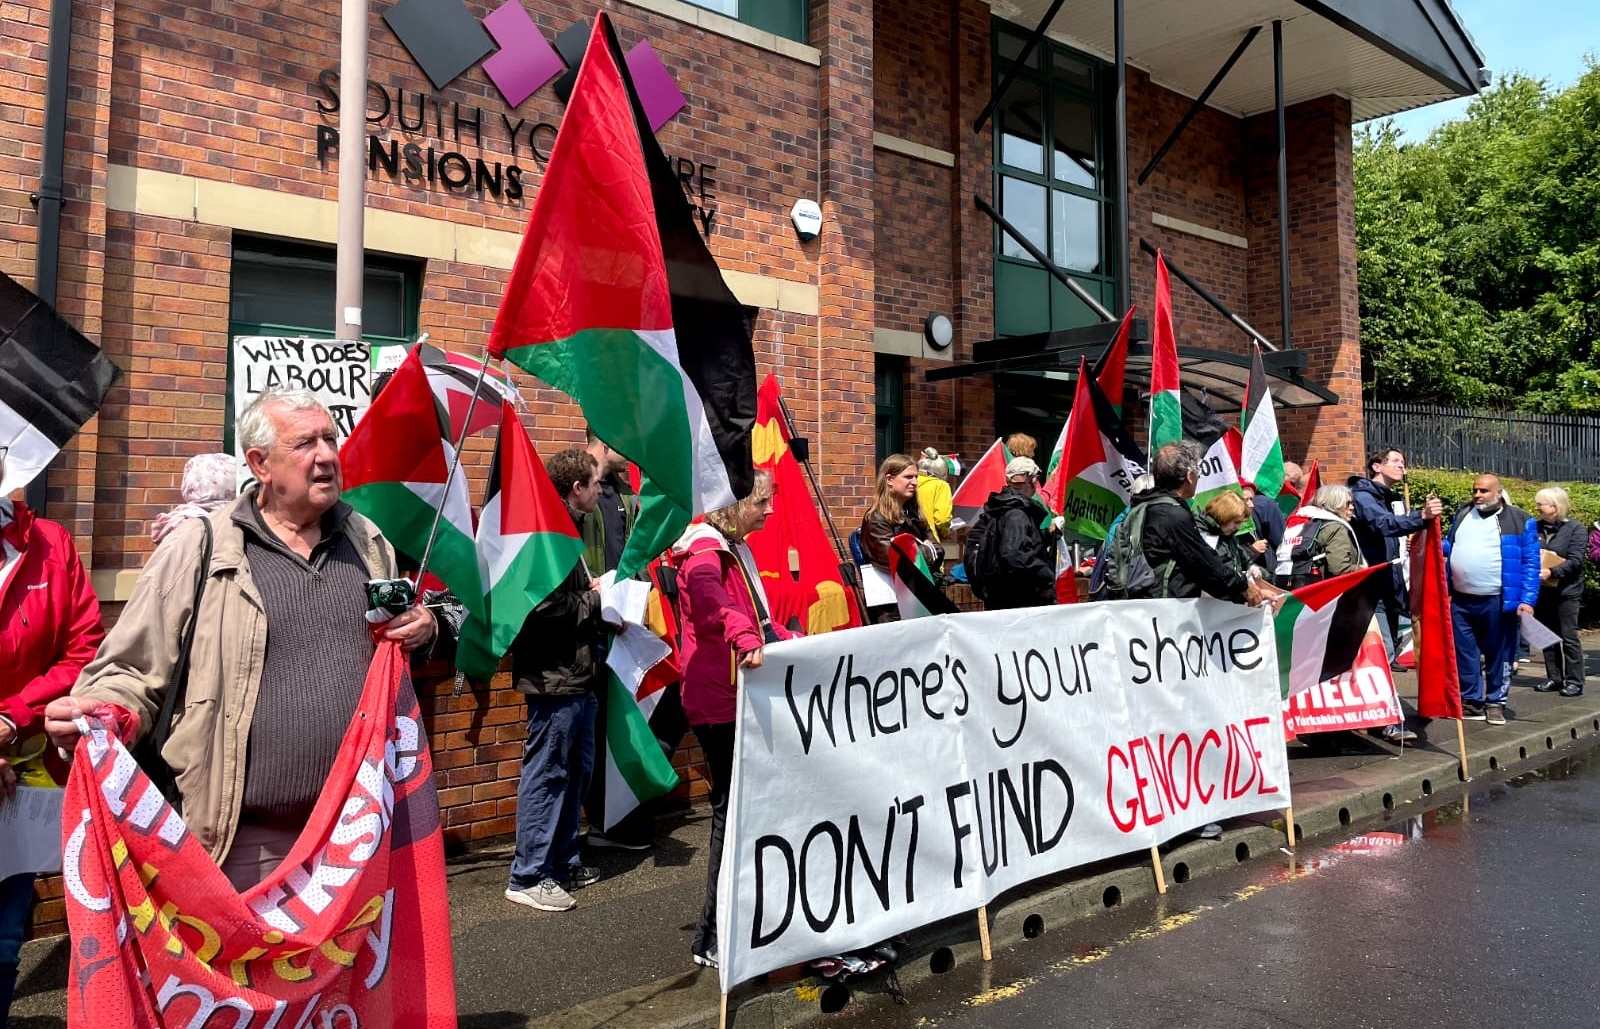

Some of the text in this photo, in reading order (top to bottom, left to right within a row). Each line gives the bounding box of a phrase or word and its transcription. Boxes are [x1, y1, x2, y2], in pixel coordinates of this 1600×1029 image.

[316, 125, 523, 199] PNSIONS
[243, 339, 305, 363] WHY
[311, 342, 371, 364] DOES
[246, 364, 370, 399] LABOUR
[784, 617, 1263, 755] Where's your shame
[750, 717, 1279, 949] DON'T FUND GENOCIDE
